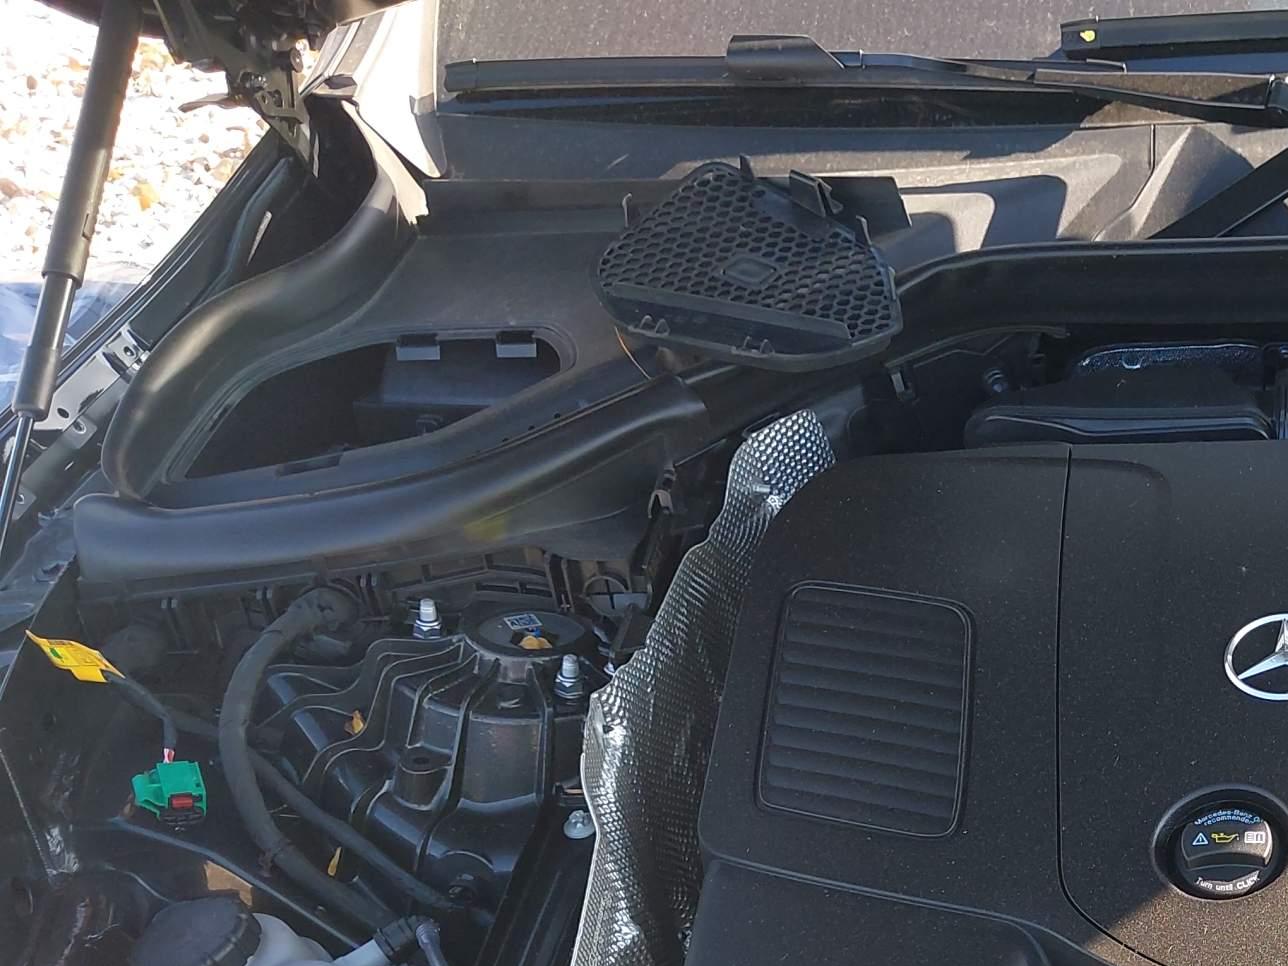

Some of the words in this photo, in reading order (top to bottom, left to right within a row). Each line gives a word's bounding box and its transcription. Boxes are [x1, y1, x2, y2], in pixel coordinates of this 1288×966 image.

[1194, 809, 1253, 824] Mercedes-Benz
[1196, 876, 1213, 890] Turn
[1215, 883, 1233, 891] until
